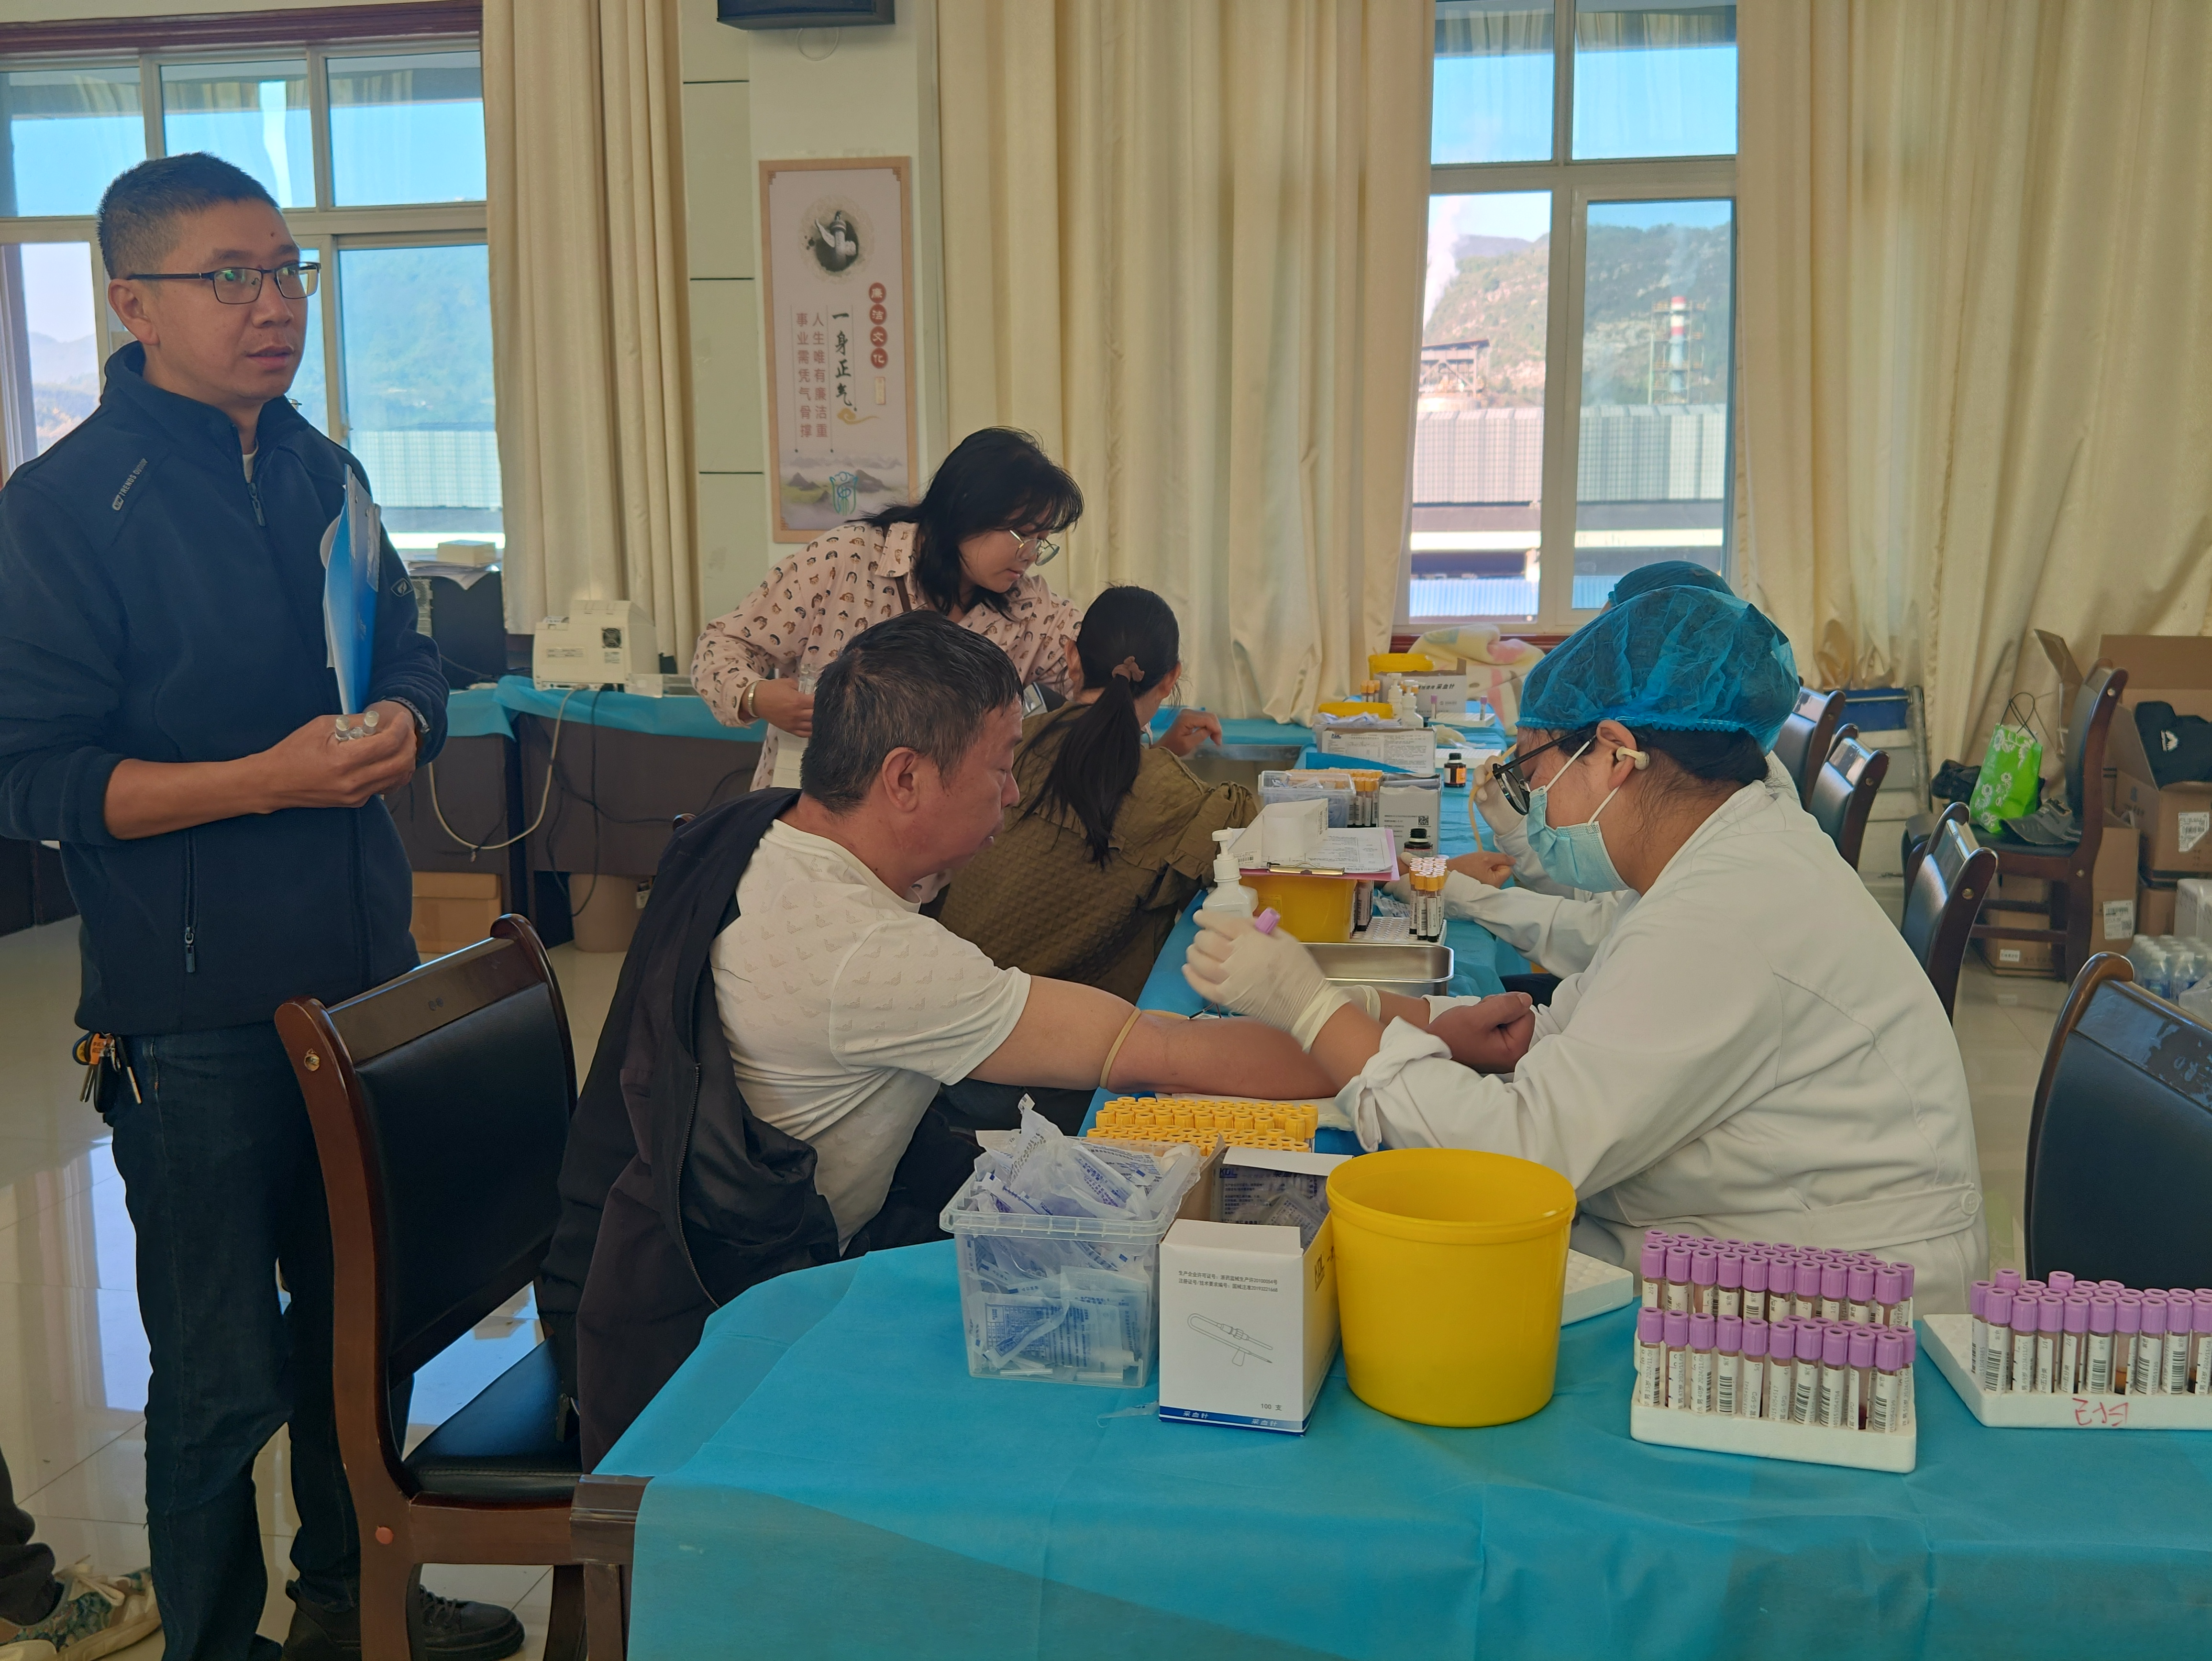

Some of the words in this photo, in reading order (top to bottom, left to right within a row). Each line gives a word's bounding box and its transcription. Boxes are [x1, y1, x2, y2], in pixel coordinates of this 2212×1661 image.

[869, 284, 886, 367] 廉洁文化
[796, 312, 813, 438] 事业需凭气骨撑
[813, 312, 828, 438] 人生唯有廉洁重
[832, 311, 852, 406] 一身正气
[119, 474, 137, 497] TRENDS
[1219, 1168, 1238, 1176] KDL
[1315, 1252, 1325, 1283] KDL
[1183, 1411, 1209, 1419] 采血针
